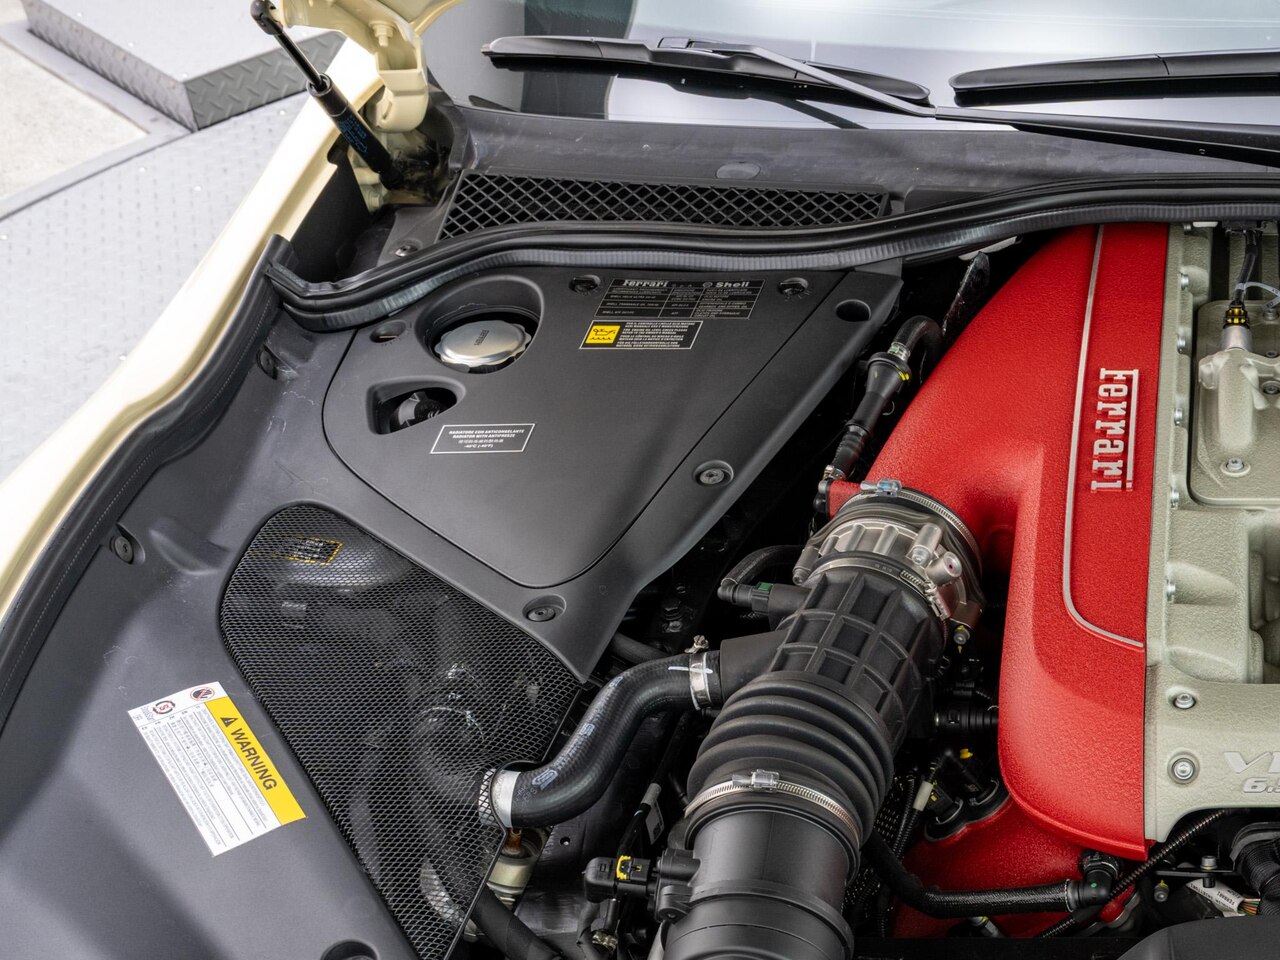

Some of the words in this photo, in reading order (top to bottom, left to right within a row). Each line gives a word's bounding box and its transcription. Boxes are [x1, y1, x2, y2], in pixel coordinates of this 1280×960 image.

[622, 279, 669, 287] Ferrari
[1090, 367, 1139, 493] Ferrari
[230, 727, 278, 791] WARNING
